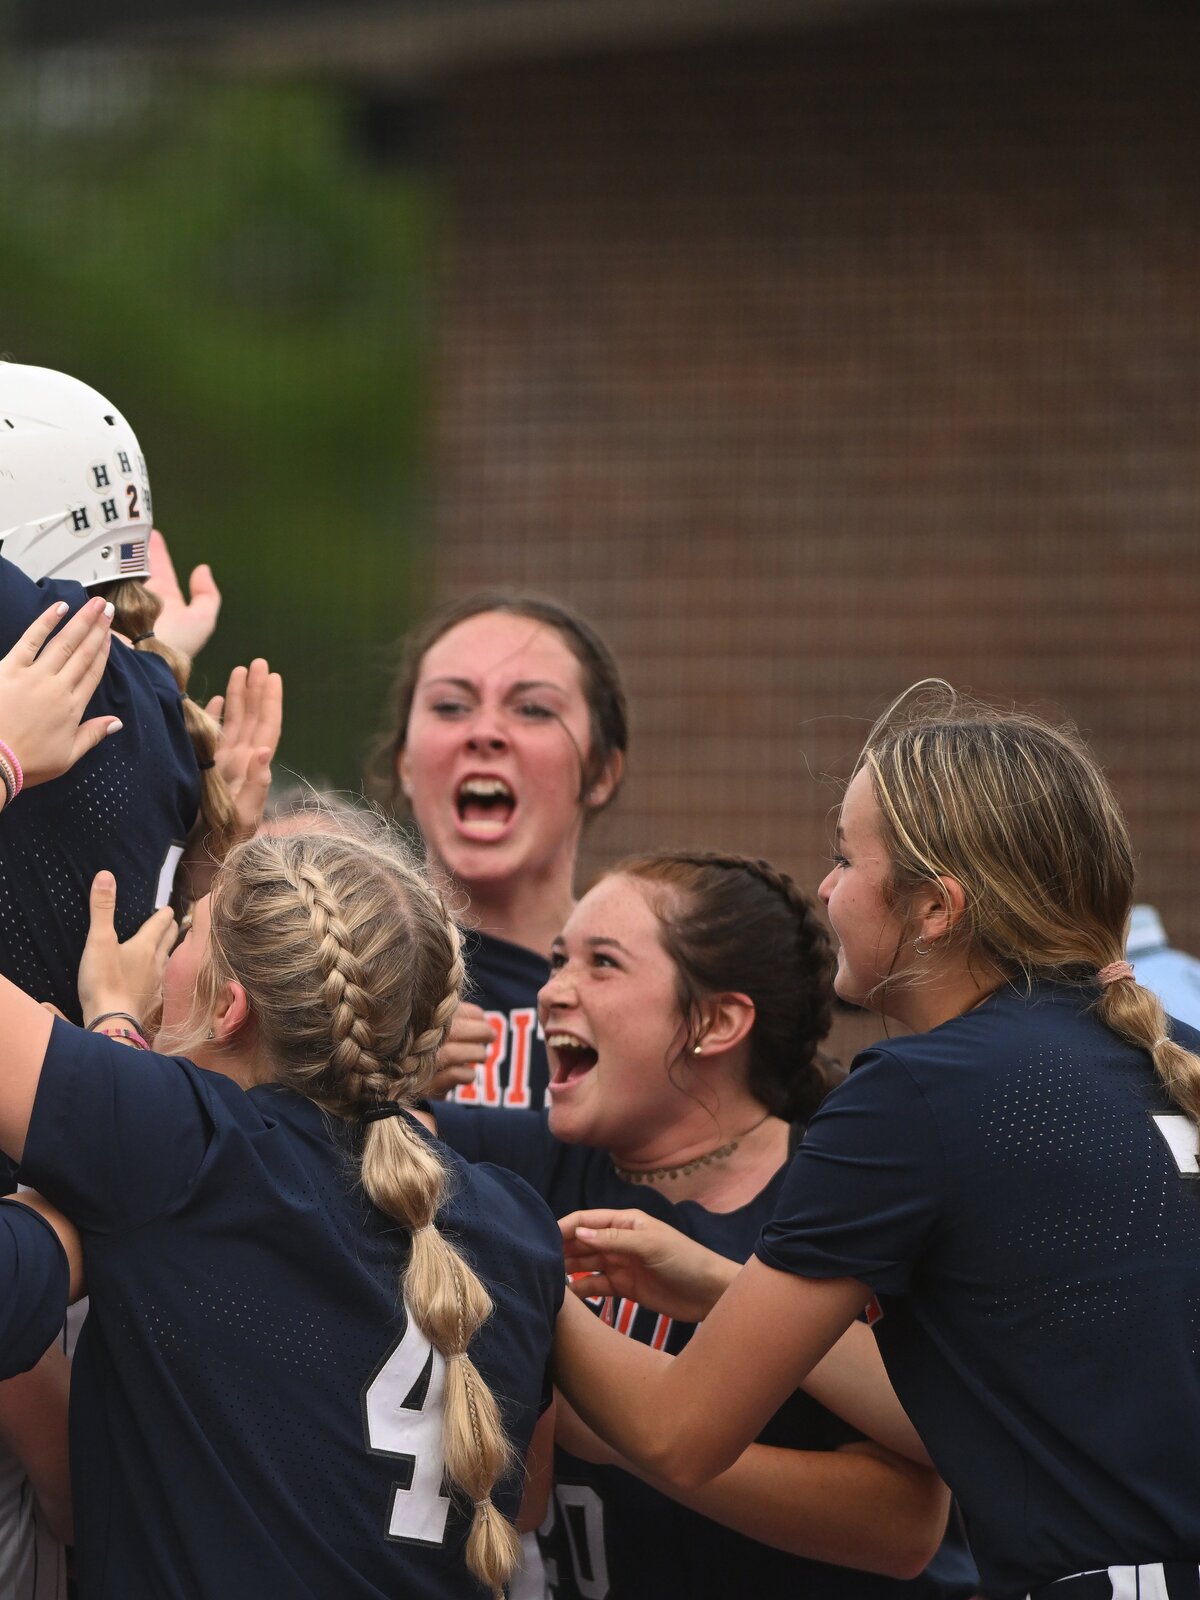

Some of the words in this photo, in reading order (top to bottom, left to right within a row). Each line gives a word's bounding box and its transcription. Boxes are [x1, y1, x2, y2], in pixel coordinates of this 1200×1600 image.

[117, 452, 132, 472] H
[92, 465, 110, 487] H
[101, 499, 119, 522] H
[126, 484, 140, 519] 2
[71, 507, 90, 531] H
[365, 1298, 451, 1545] 4
